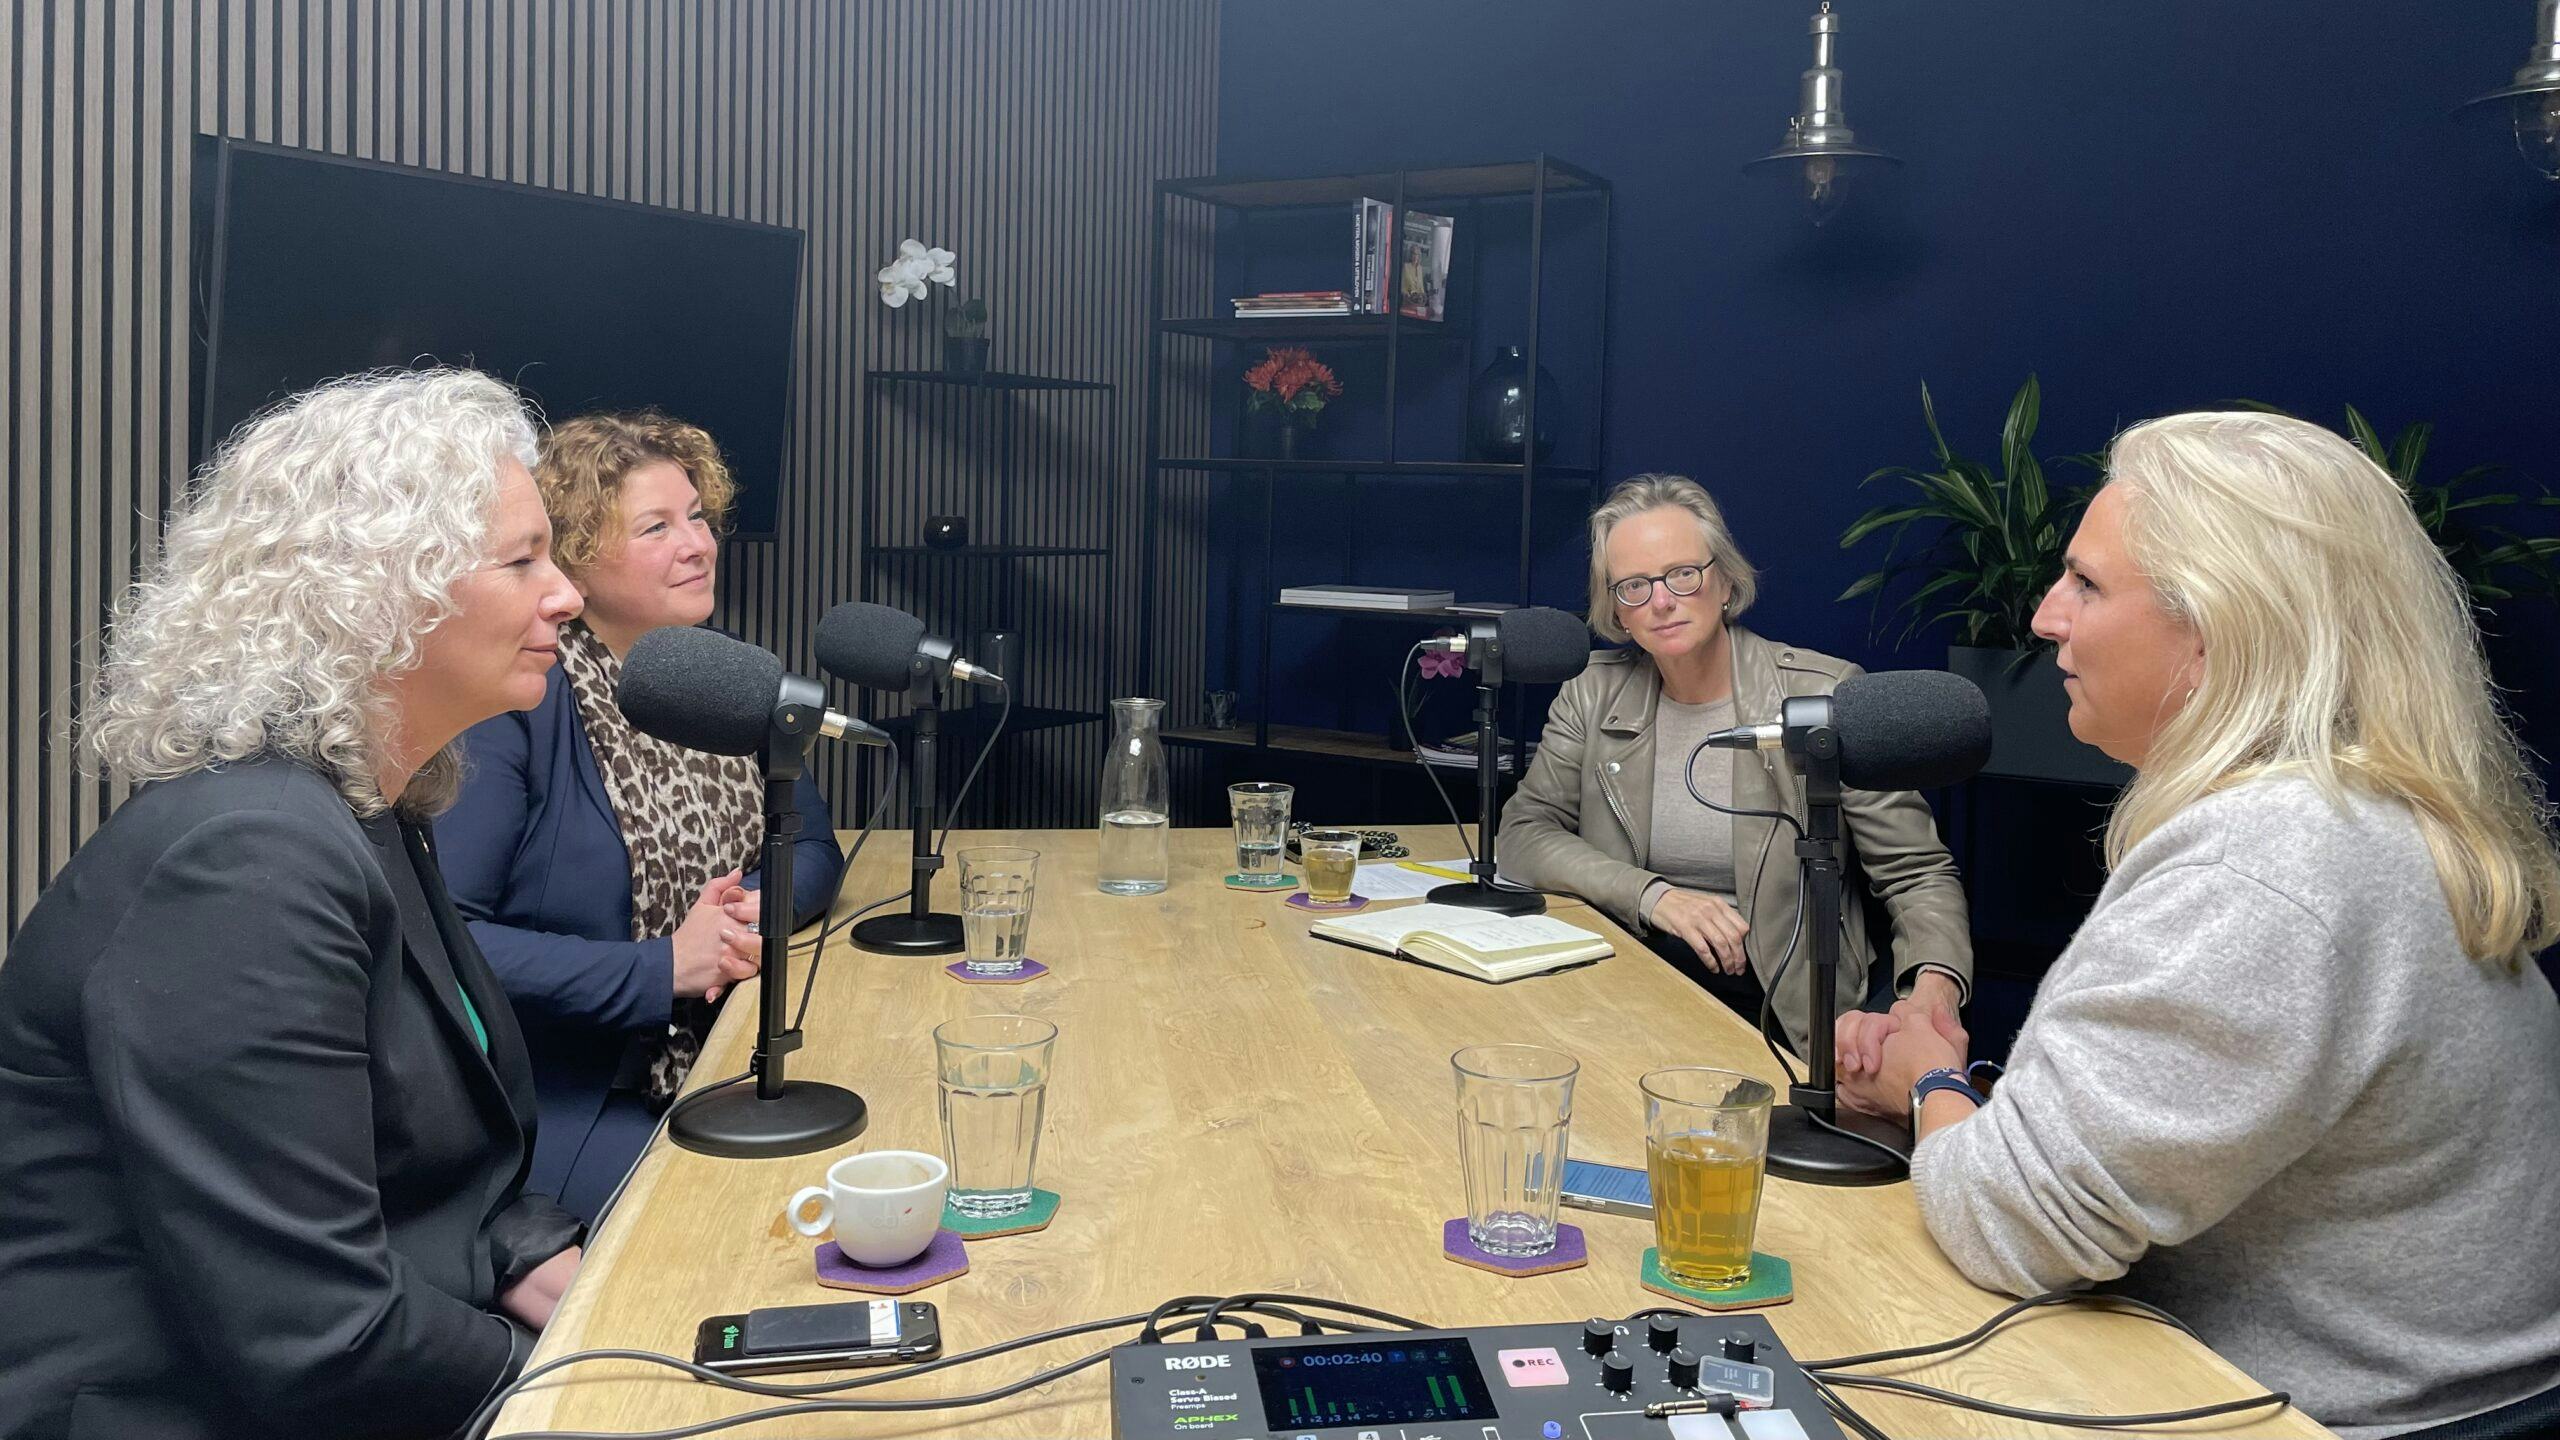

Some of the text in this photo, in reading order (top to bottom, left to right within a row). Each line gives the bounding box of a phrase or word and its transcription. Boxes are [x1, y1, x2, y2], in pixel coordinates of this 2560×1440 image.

[1165, 1355, 1232, 1371] RØDE
[1303, 1352, 1383, 1367] 00:02:40
[1527, 1358, 1555, 1367] REC
[1169, 1388, 1207, 1397] Class-A
[1170, 1393, 1238, 1404] Servo Biased
[1460, 1407, 1469, 1415] R
[1174, 1413, 1239, 1424] APHEX
[1189, 1422, 1214, 1430] board
